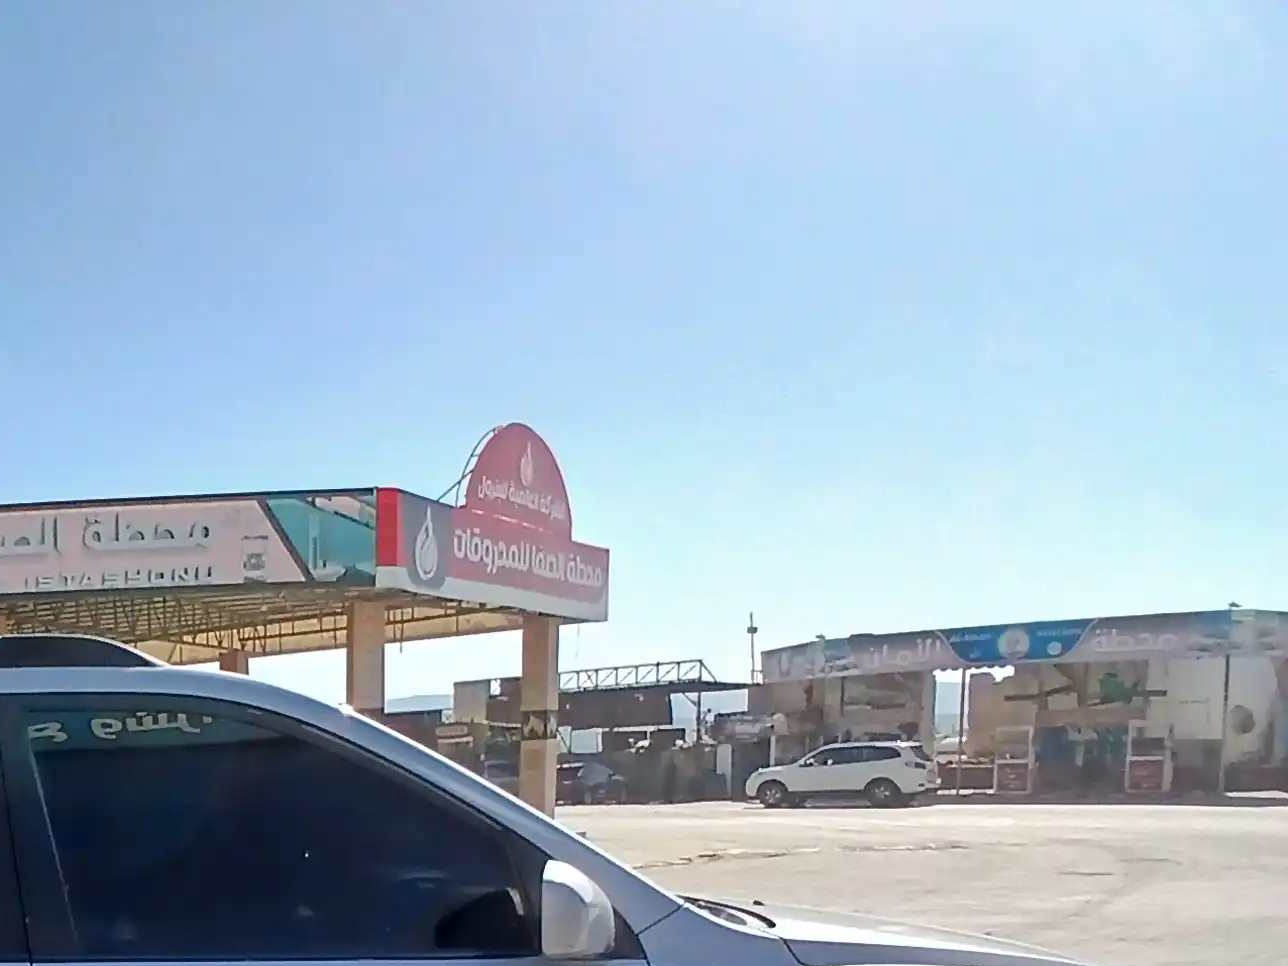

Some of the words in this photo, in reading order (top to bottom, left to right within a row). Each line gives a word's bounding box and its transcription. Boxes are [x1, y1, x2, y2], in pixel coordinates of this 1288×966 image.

[83, 511, 213, 552] محطة
[452, 527, 530, 574] للمحروقات
[532, 543, 566, 583] الصفا
[566, 553, 603, 588] محطة
